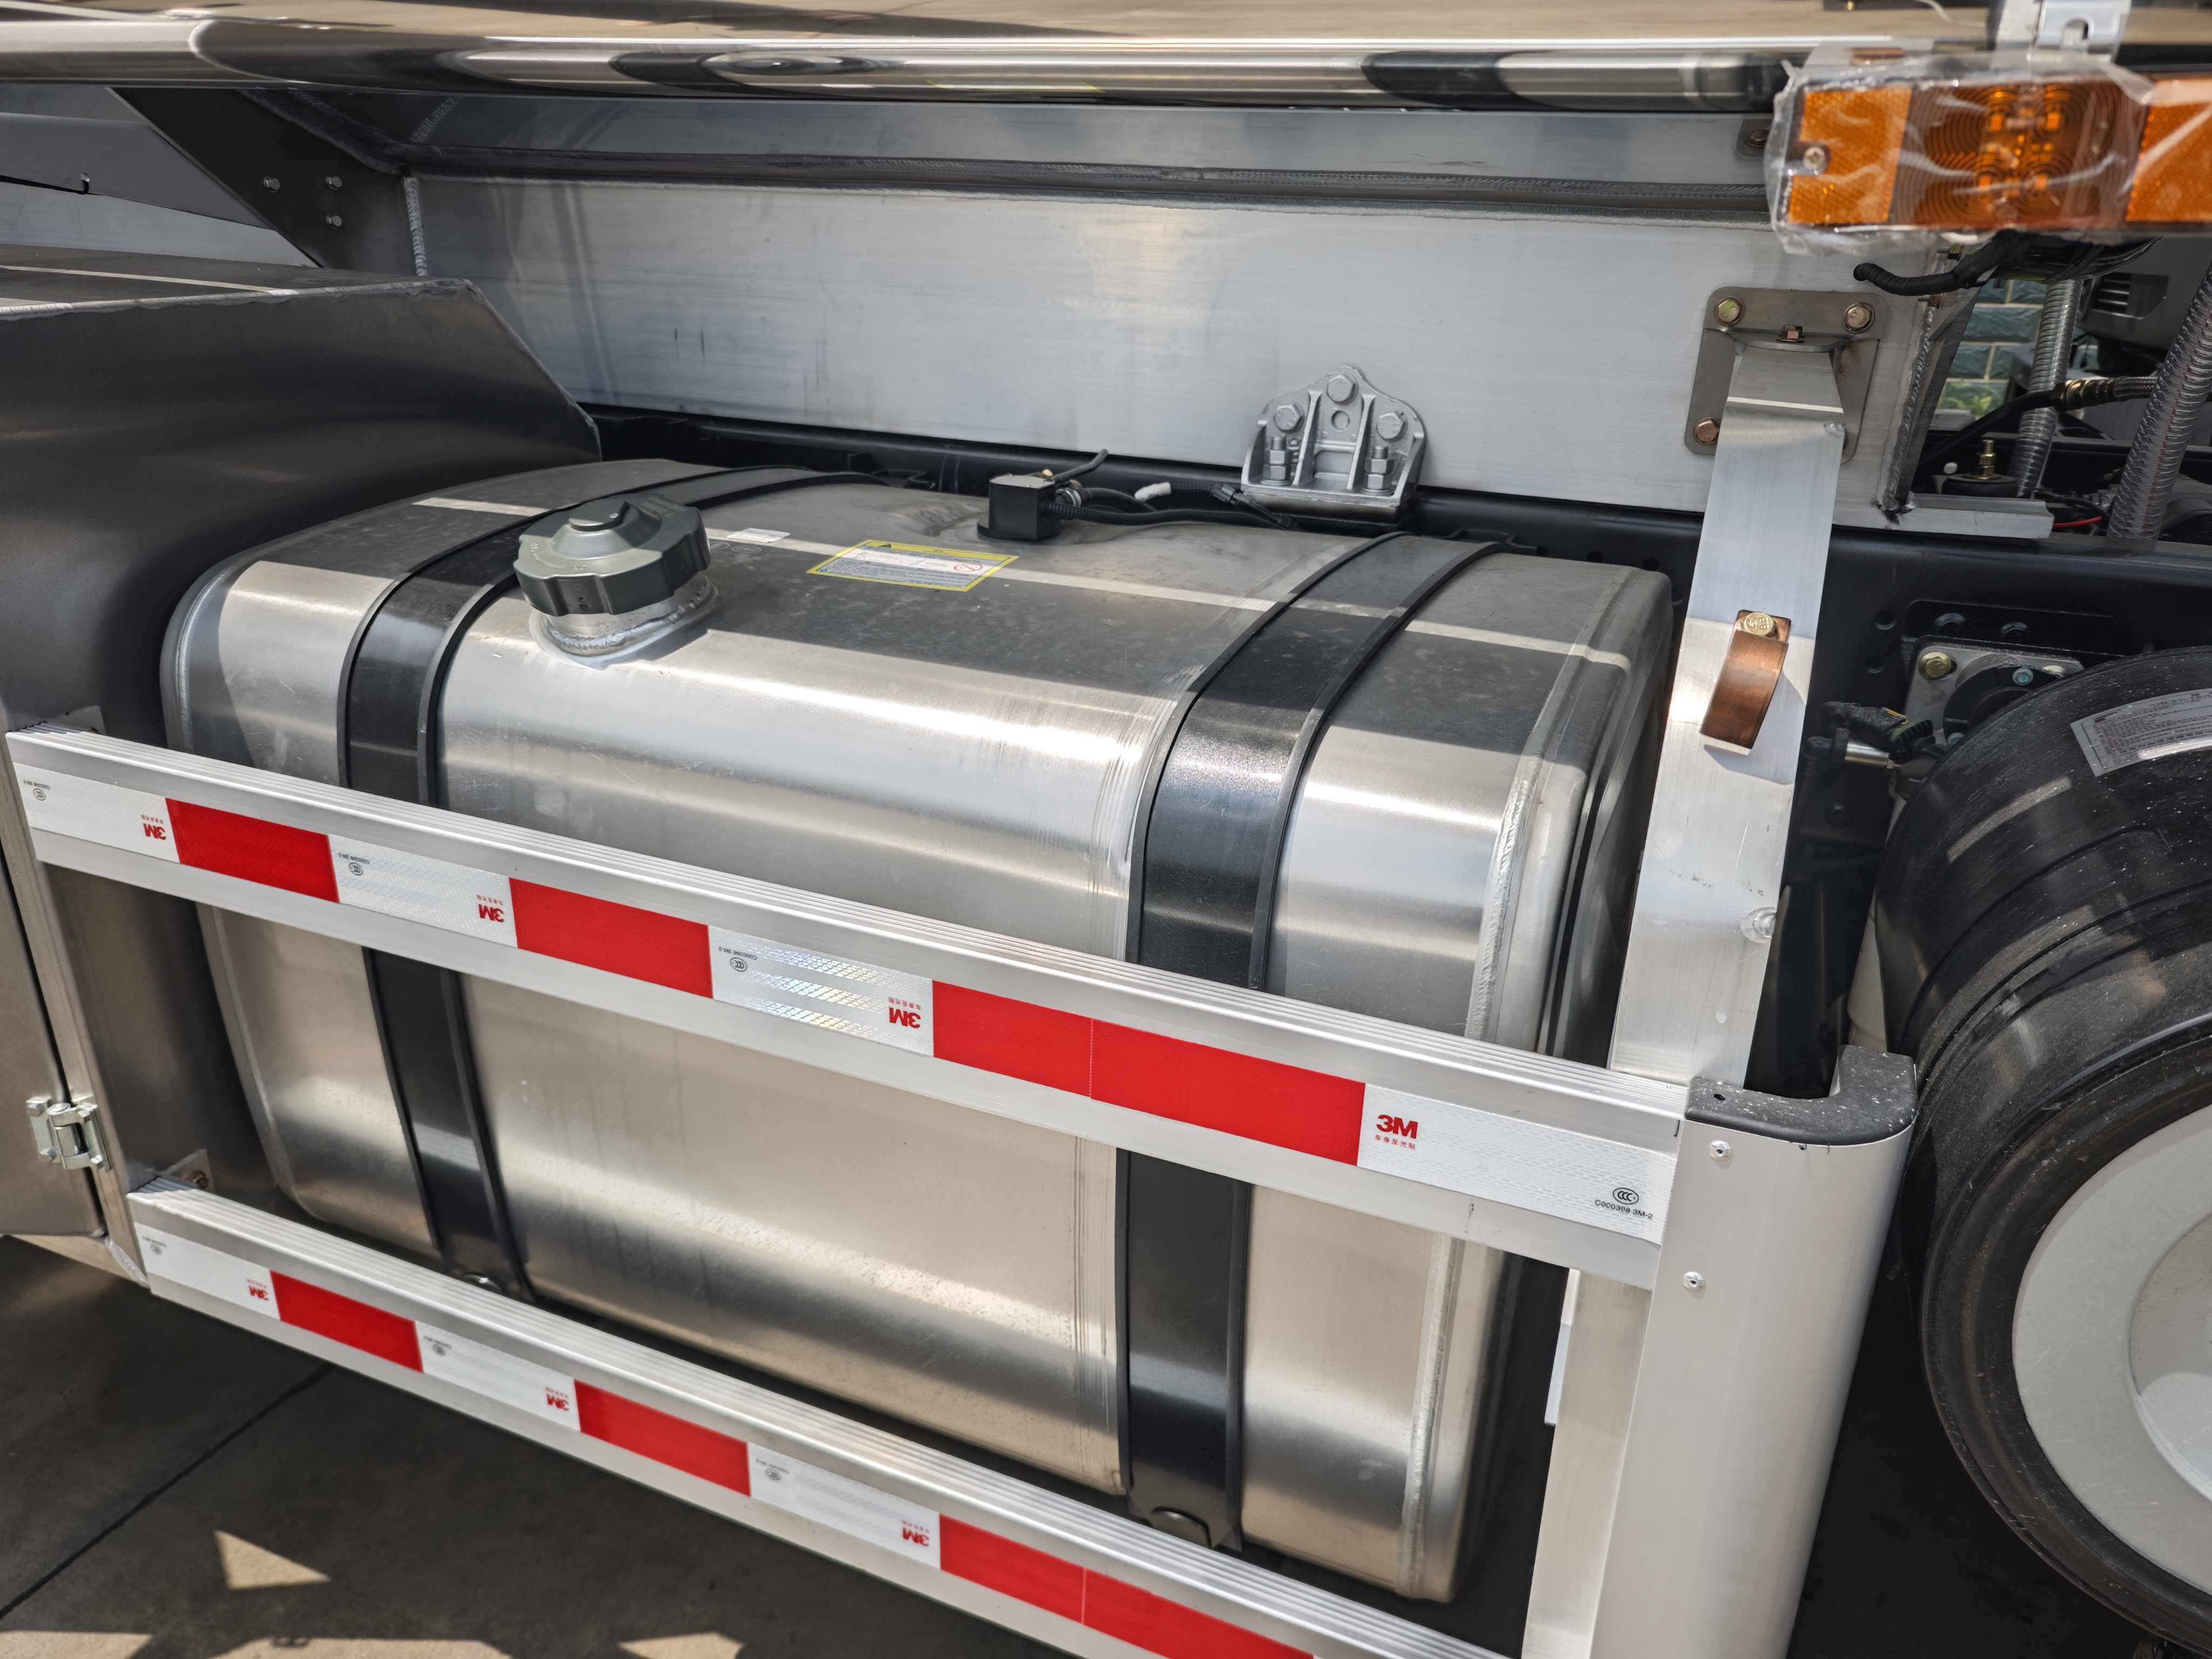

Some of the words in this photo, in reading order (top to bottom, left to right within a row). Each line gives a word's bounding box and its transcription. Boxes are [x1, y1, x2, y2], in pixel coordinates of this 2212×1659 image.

[143, 822, 166, 840] 3M
[478, 903, 505, 923] 3M
[888, 1007, 921, 1029] 3M
[1376, 1114, 1419, 1139] 3M
[1374, 1134, 1416, 1150] 车身反光贴
[1594, 1199, 1631, 1213] C000398
[1632, 1209, 1654, 1220] 3M-2
[248, 1285, 269, 1301] 3M
[546, 1393, 569, 1411] 3M
[902, 1526, 929, 1547] 3M
